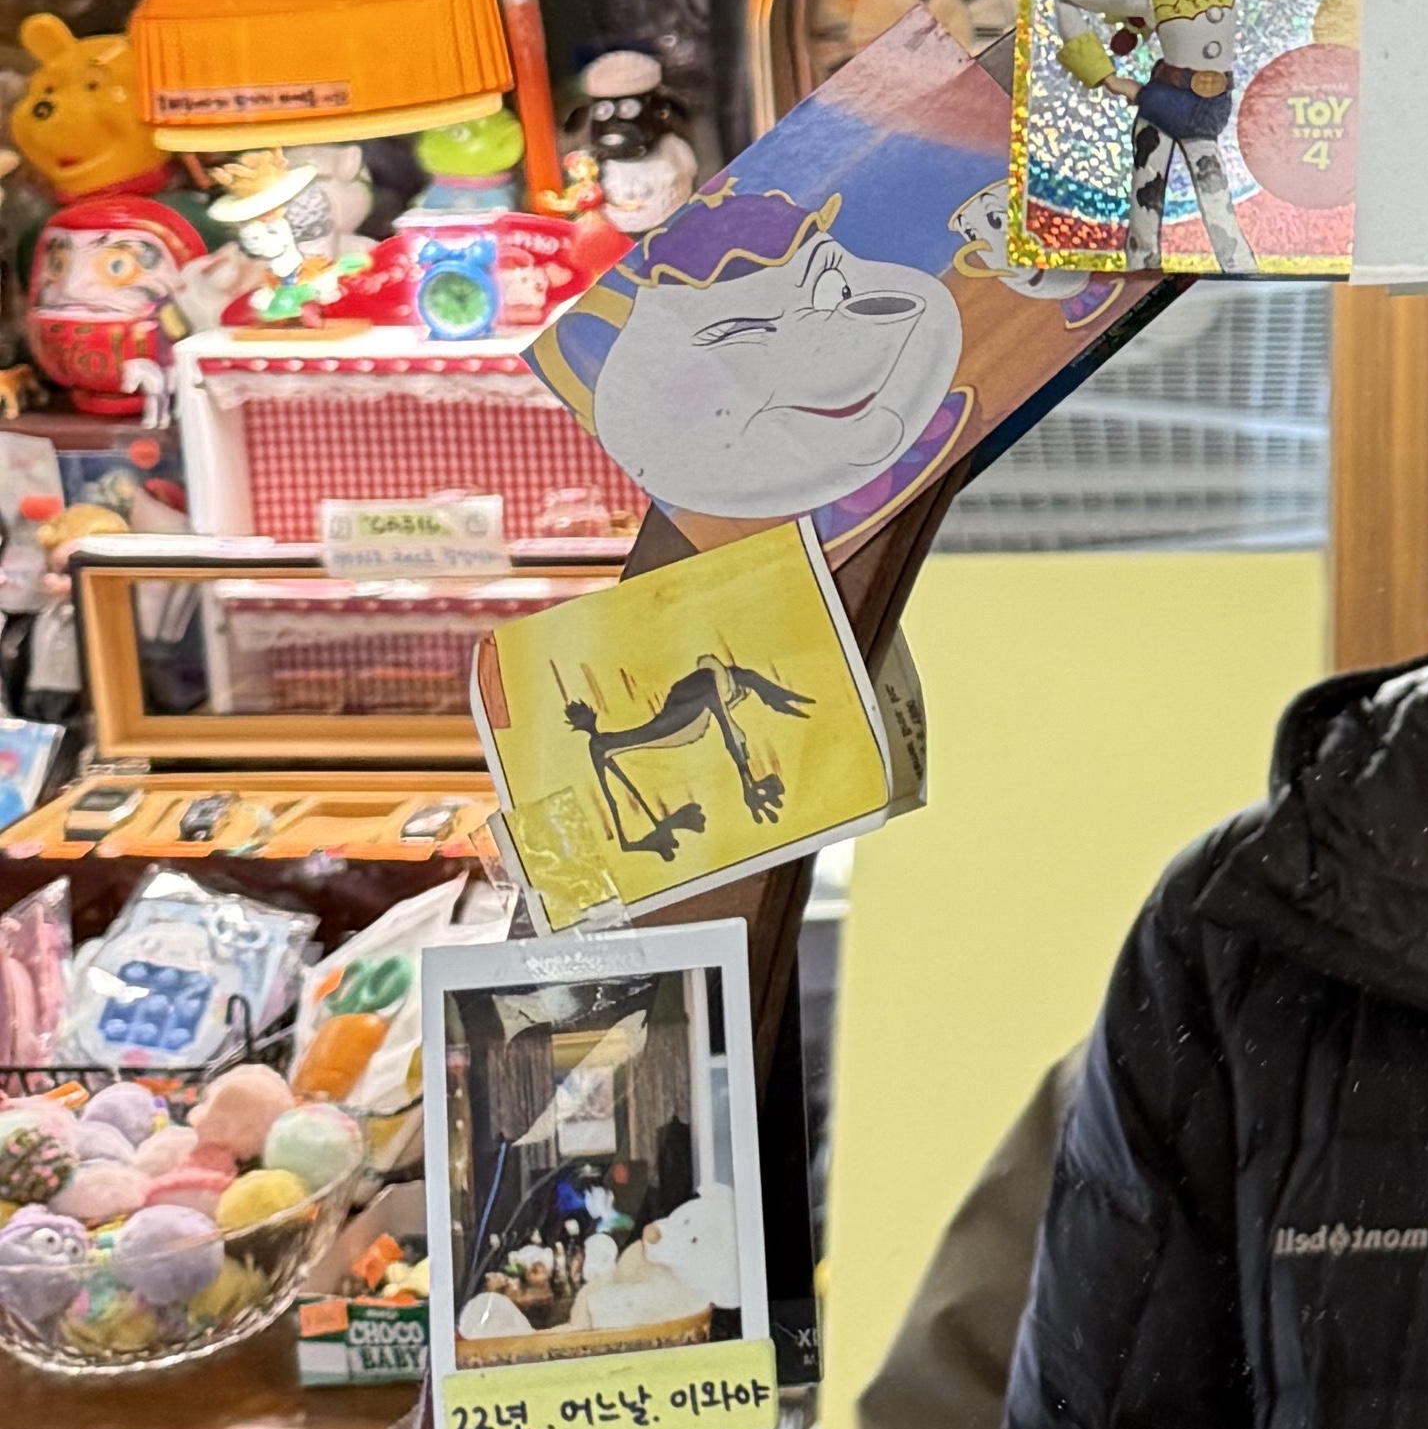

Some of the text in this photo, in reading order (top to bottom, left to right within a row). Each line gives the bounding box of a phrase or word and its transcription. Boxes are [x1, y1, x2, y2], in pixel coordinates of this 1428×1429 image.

[1286, 95, 1354, 126] TOY
[1302, 139, 1331, 171] 4
[349, 1320, 425, 1345] CHOCO
[670, 1378, 771, 1416] 이와야
